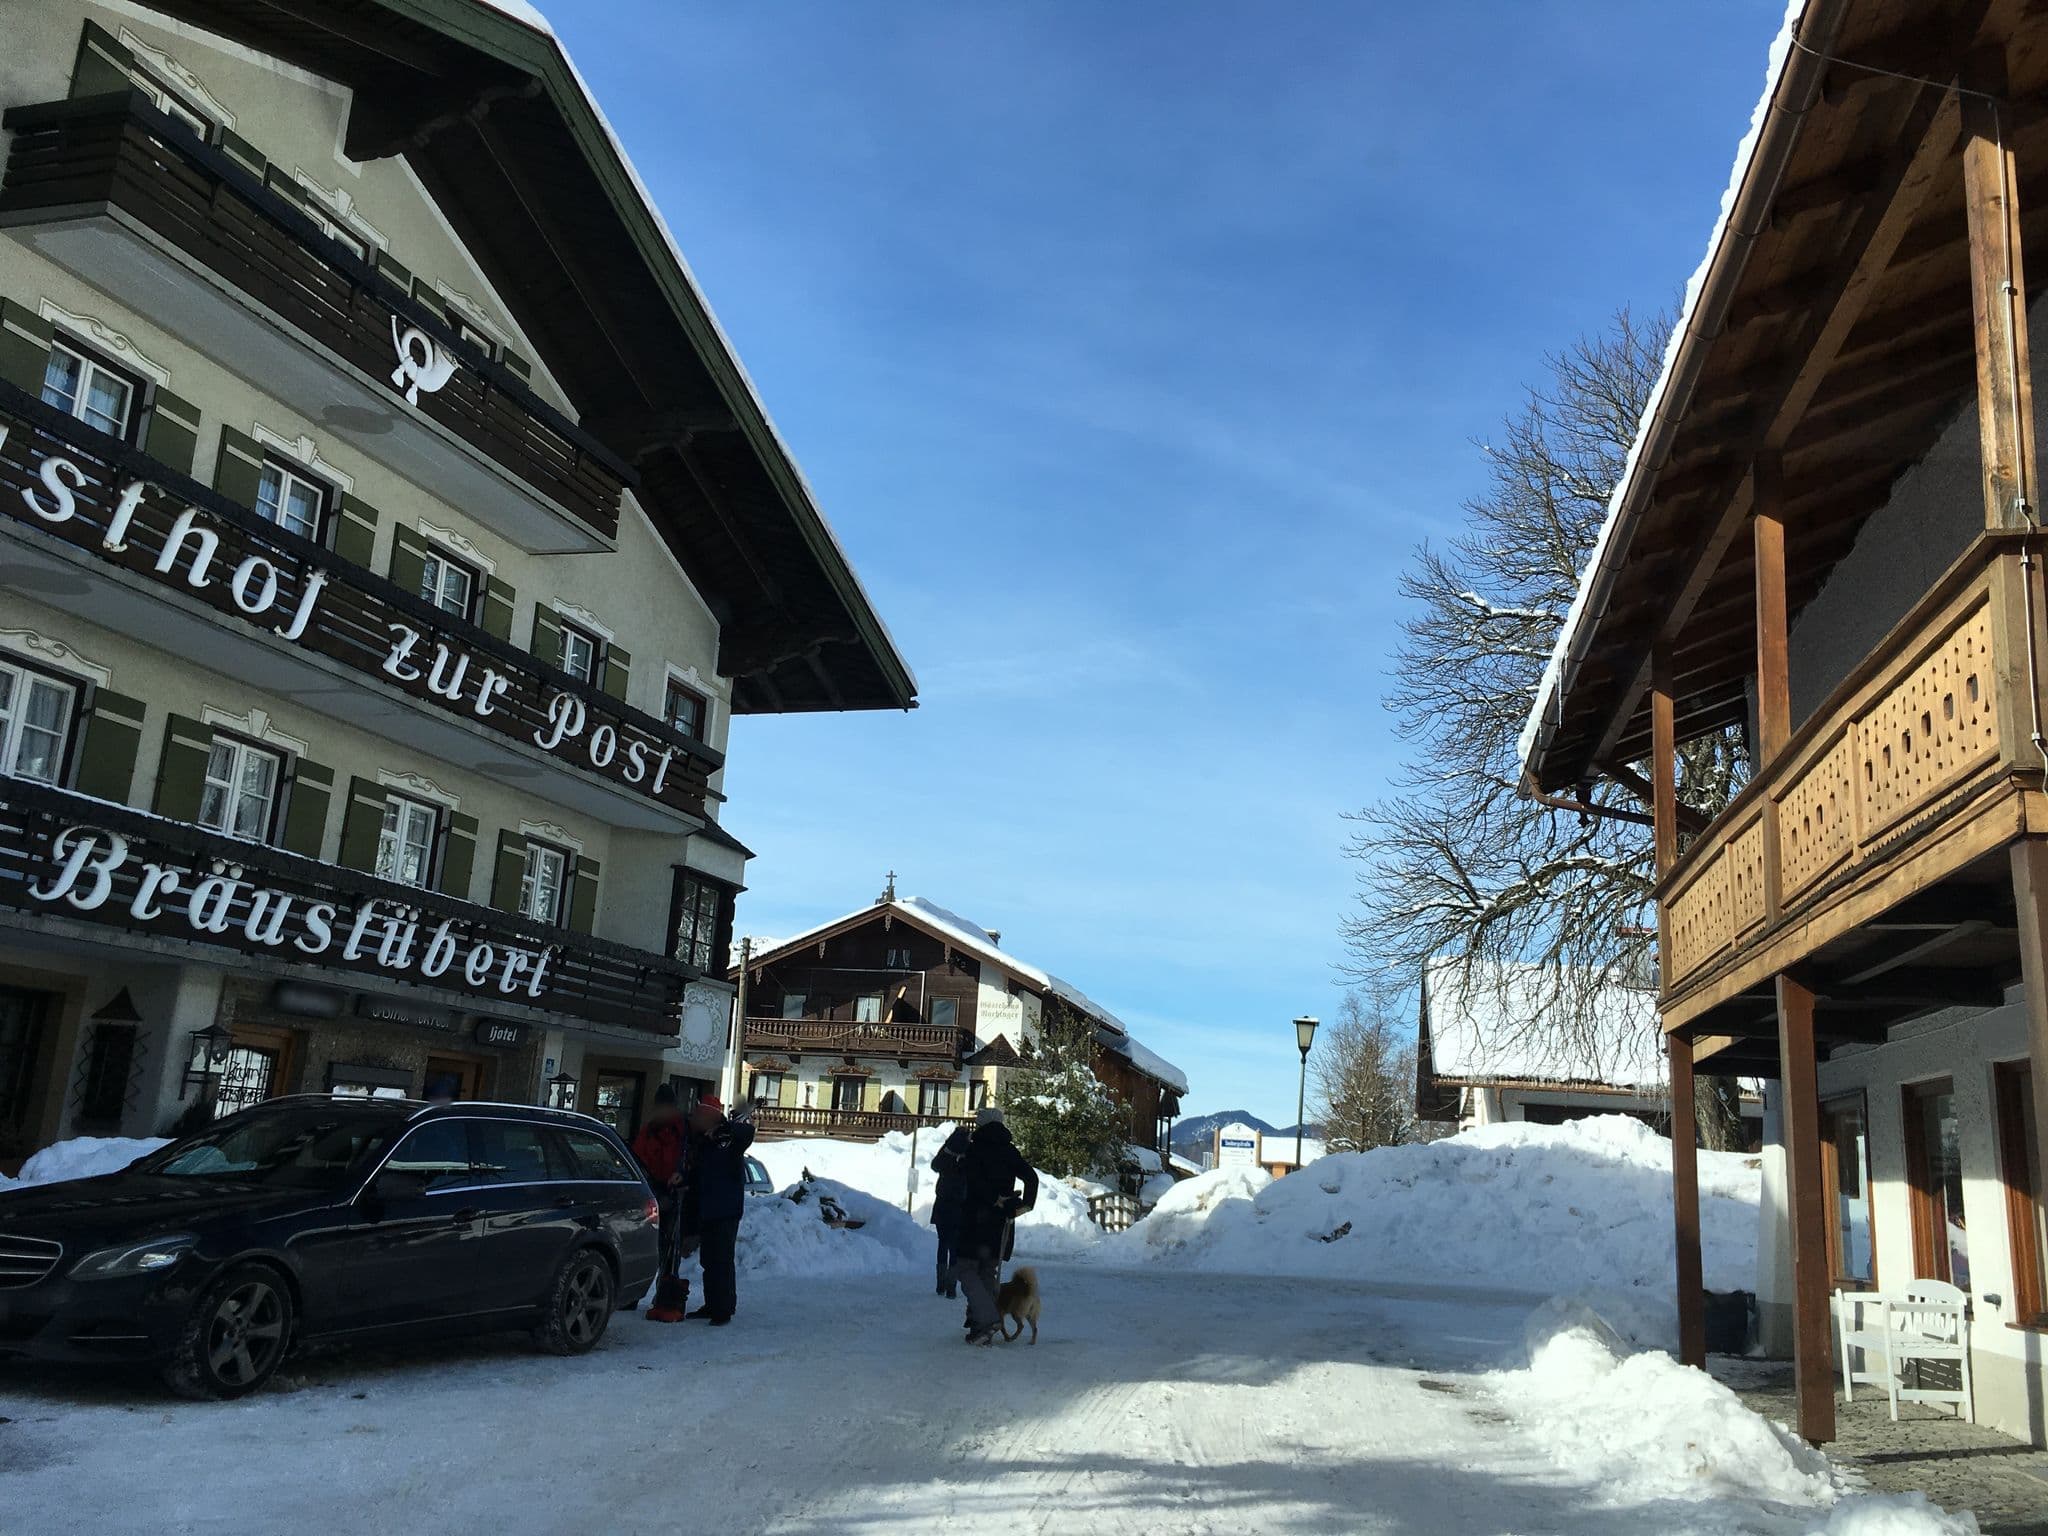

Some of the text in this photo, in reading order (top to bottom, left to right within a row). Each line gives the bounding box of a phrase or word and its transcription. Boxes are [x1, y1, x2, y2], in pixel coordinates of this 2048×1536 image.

[0, 424, 685, 795] sthof zur Post
[28, 824, 563, 998] Bräustüberl
